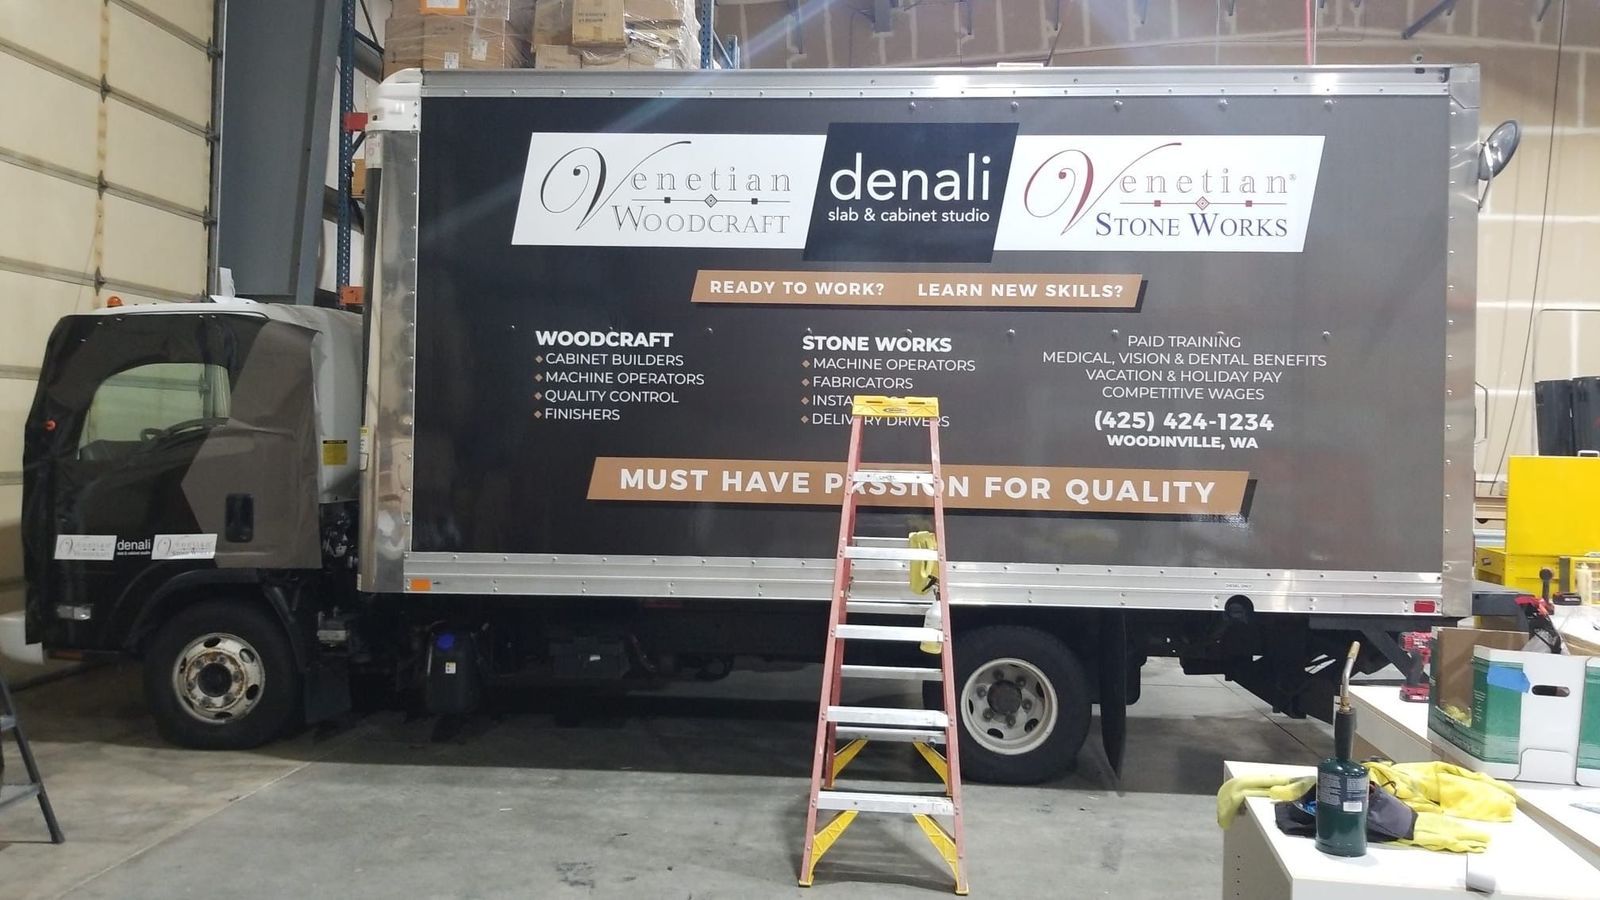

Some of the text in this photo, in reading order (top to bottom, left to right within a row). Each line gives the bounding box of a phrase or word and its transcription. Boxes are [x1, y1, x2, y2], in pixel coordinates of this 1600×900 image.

[829, 152, 991, 201] denali
[540, 141, 791, 231] Venetian
[828, 206, 990, 222] slab & cabinet studio
[1095, 212, 1288, 238] STONE WORKS
[710, 280, 1124, 298] READY TO WORK? LEARN NEW SKILLS?
[535, 330, 674, 348] WOODCRAFT
[802, 335, 953, 353] STONE WORKS
[1127, 335, 1242, 348] PAID TRAINING
[545, 352, 684, 367] CABINET BUILDERS
[813, 357, 976, 372] MACHINE OPERATORS
[1043, 351, 1328, 367] MEDICAL, VISION & DENTAL BENEFITS
[546, 371, 705, 386] MACHINE OPERATORS
[813, 375, 914, 389] FABRICATORS
[1085, 368, 1283, 383] VACATION & HOLIDAY PAY
[544, 390, 679, 404] QUALITY CONTROL
[812, 394, 854, 407] INSTA
[1102, 386, 1265, 401] COMPETITIVE WAGES
[545, 408, 621, 421] FINISHERS
[812, 413, 883, 427] DELIVRY
[1094, 410, 1275, 432] (425) 424-1234
[1106, 434, 1259, 451] WOODINVILLE, WA
[620, 468, 709, 491] MUST
[722, 470, 810, 493] HAVE
[985, 476, 1051, 500] FOR
[1065, 478, 1216, 506] QUALITY
[117, 539, 151, 551] denali
